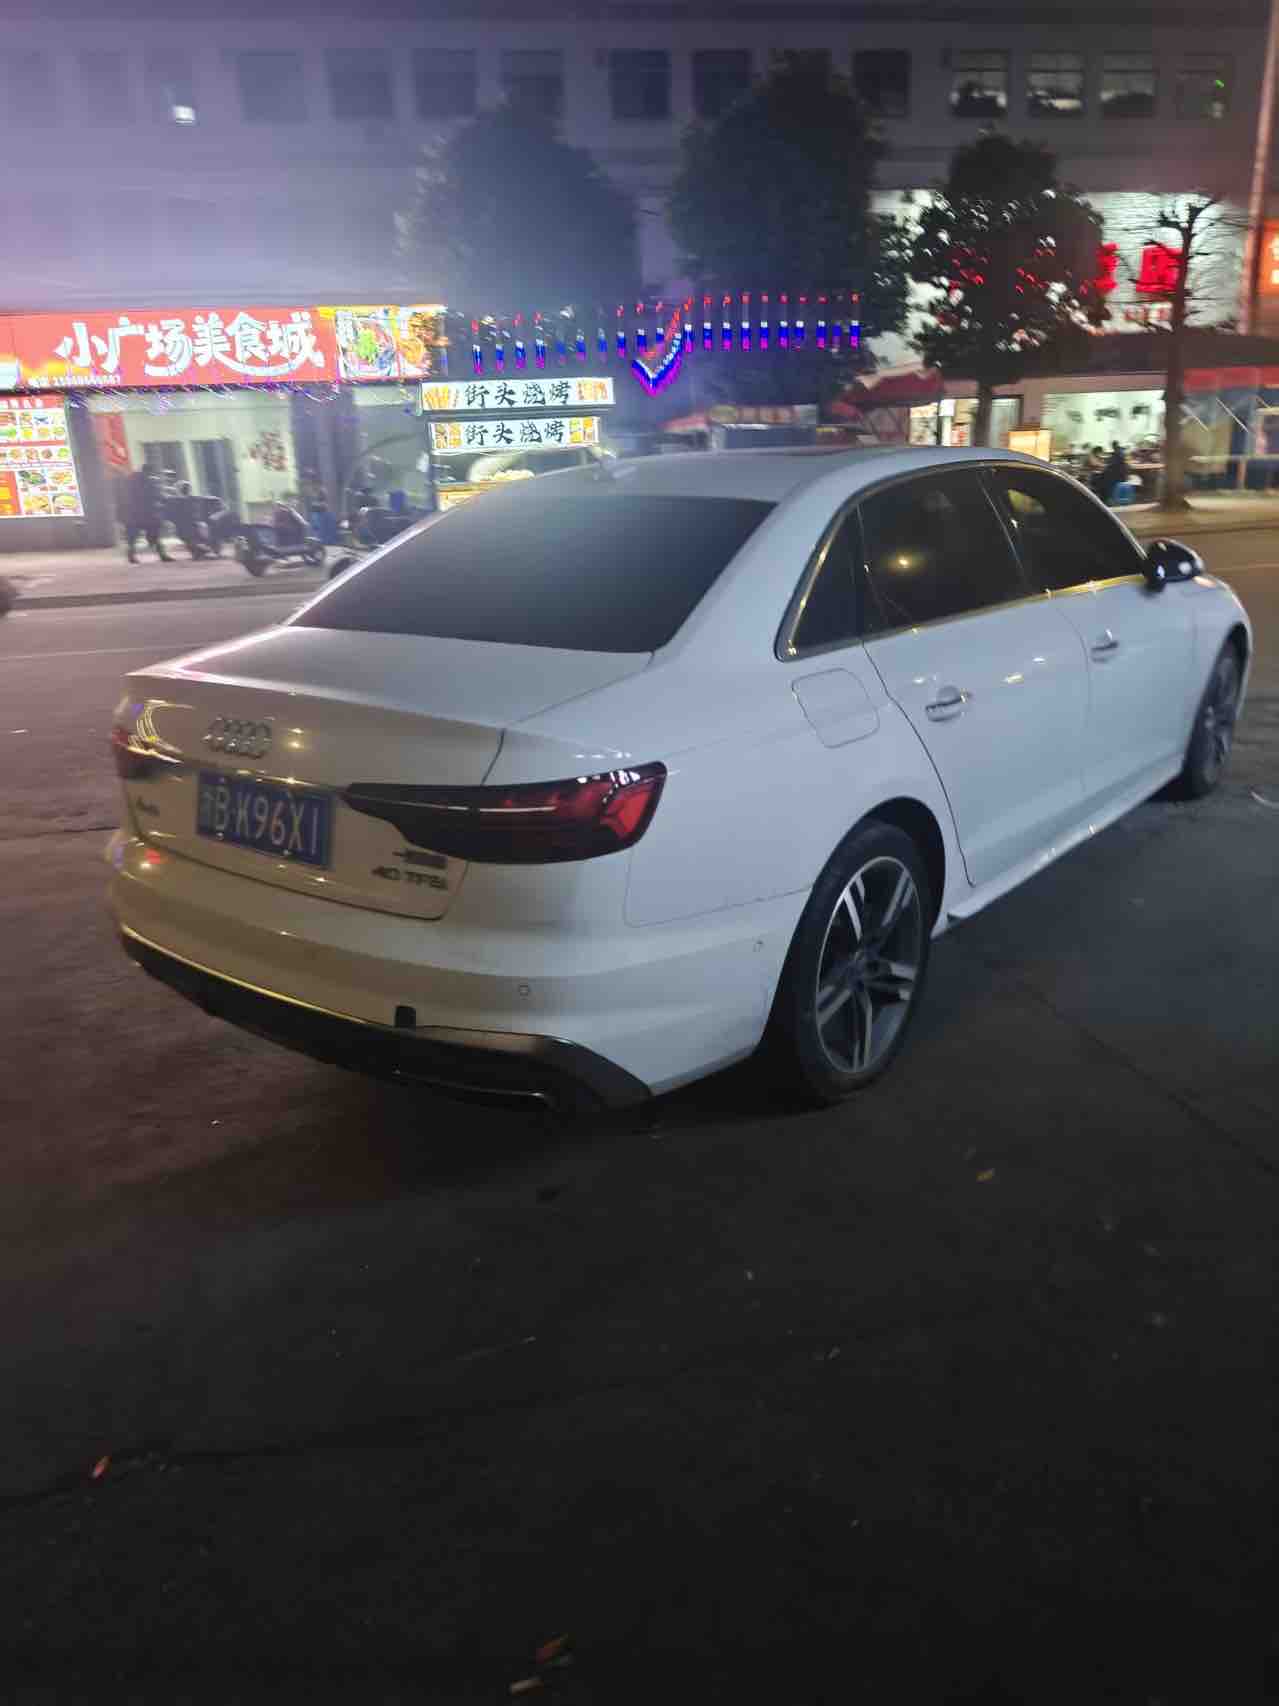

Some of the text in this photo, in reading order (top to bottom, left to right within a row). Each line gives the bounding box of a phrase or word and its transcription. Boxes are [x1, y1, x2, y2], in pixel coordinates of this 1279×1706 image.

[54, 311, 326, 377] 小广场美食城
[464, 380, 572, 408] 街头烧烤
[465, 420, 566, 446] 街头烧烤
